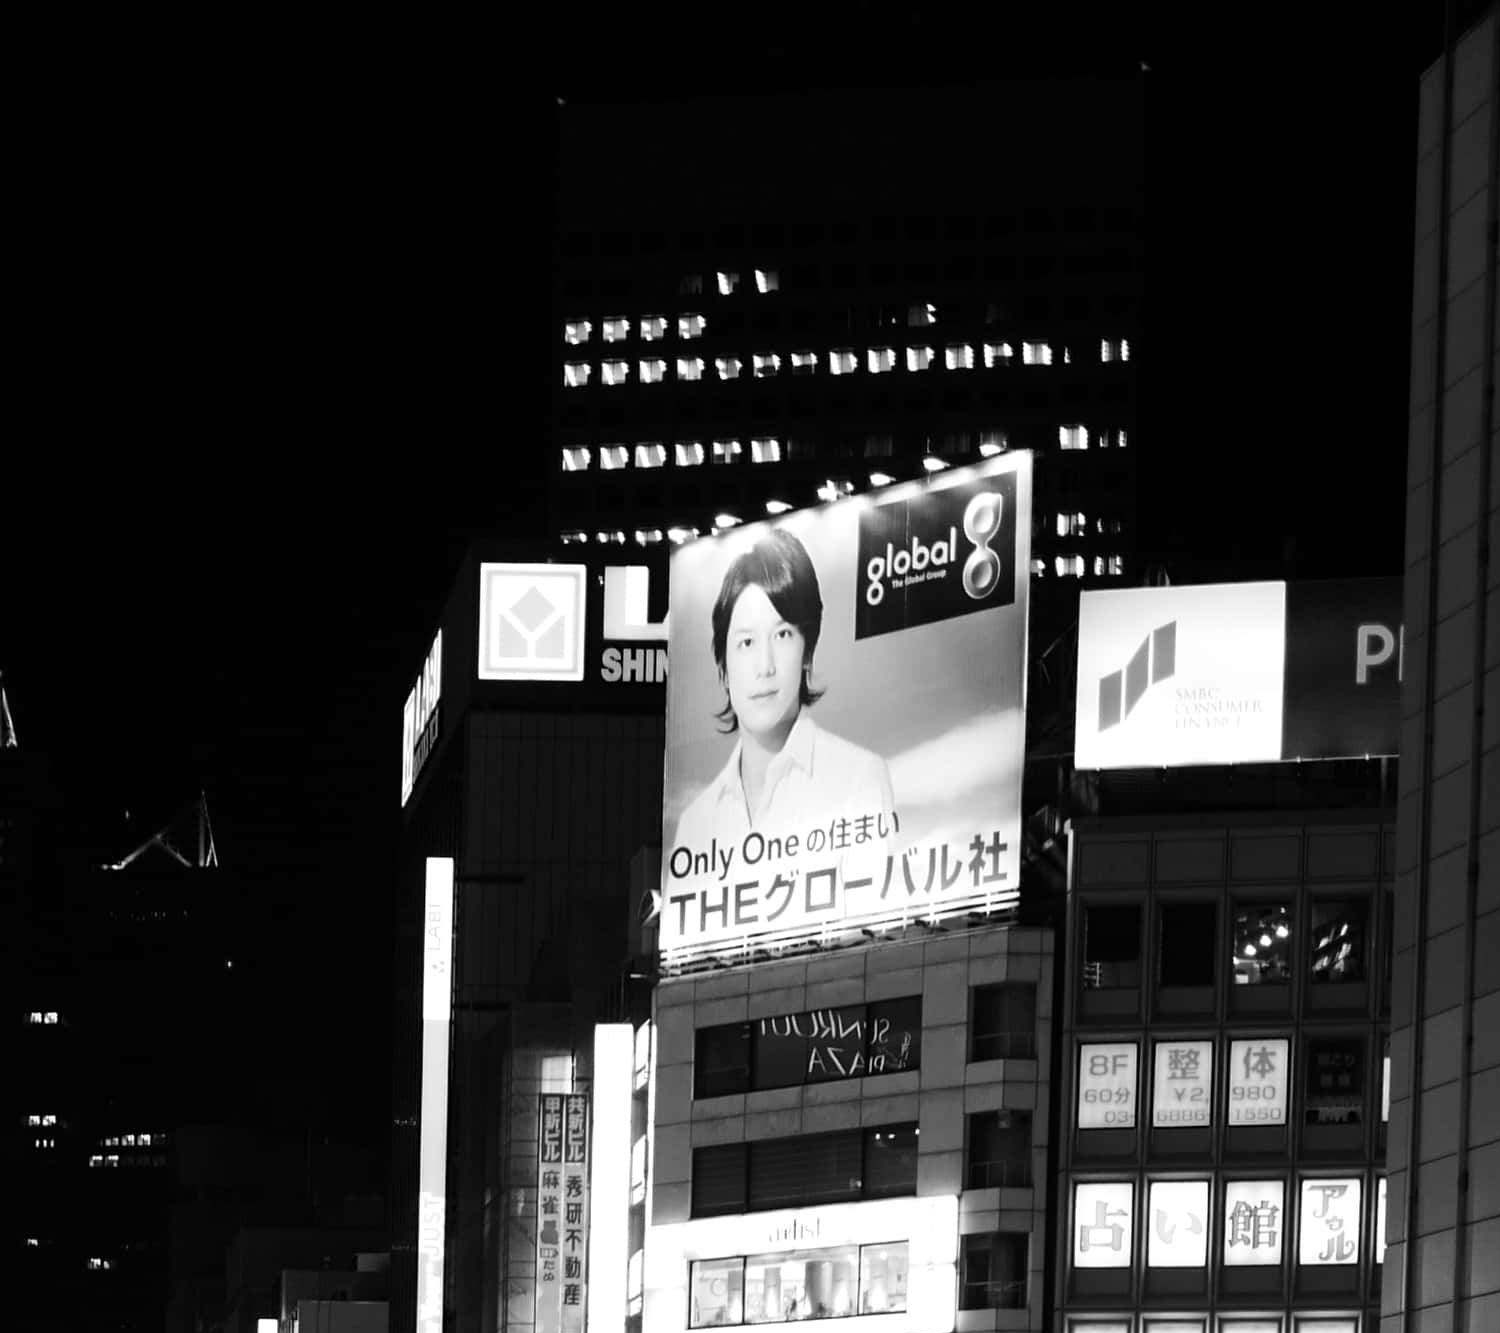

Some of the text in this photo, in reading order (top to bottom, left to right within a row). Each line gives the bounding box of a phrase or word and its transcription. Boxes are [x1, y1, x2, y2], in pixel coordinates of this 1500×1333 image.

[866, 525, 957, 606] global
[1355, 624, 1405, 685] P
[670, 811, 900, 881] Only One の住まい
[1089, 1053, 1129, 1077] 8F
[542, 1170, 559, 1215] 麻雀
[563, 1175, 583, 1306] 秀研不動産
